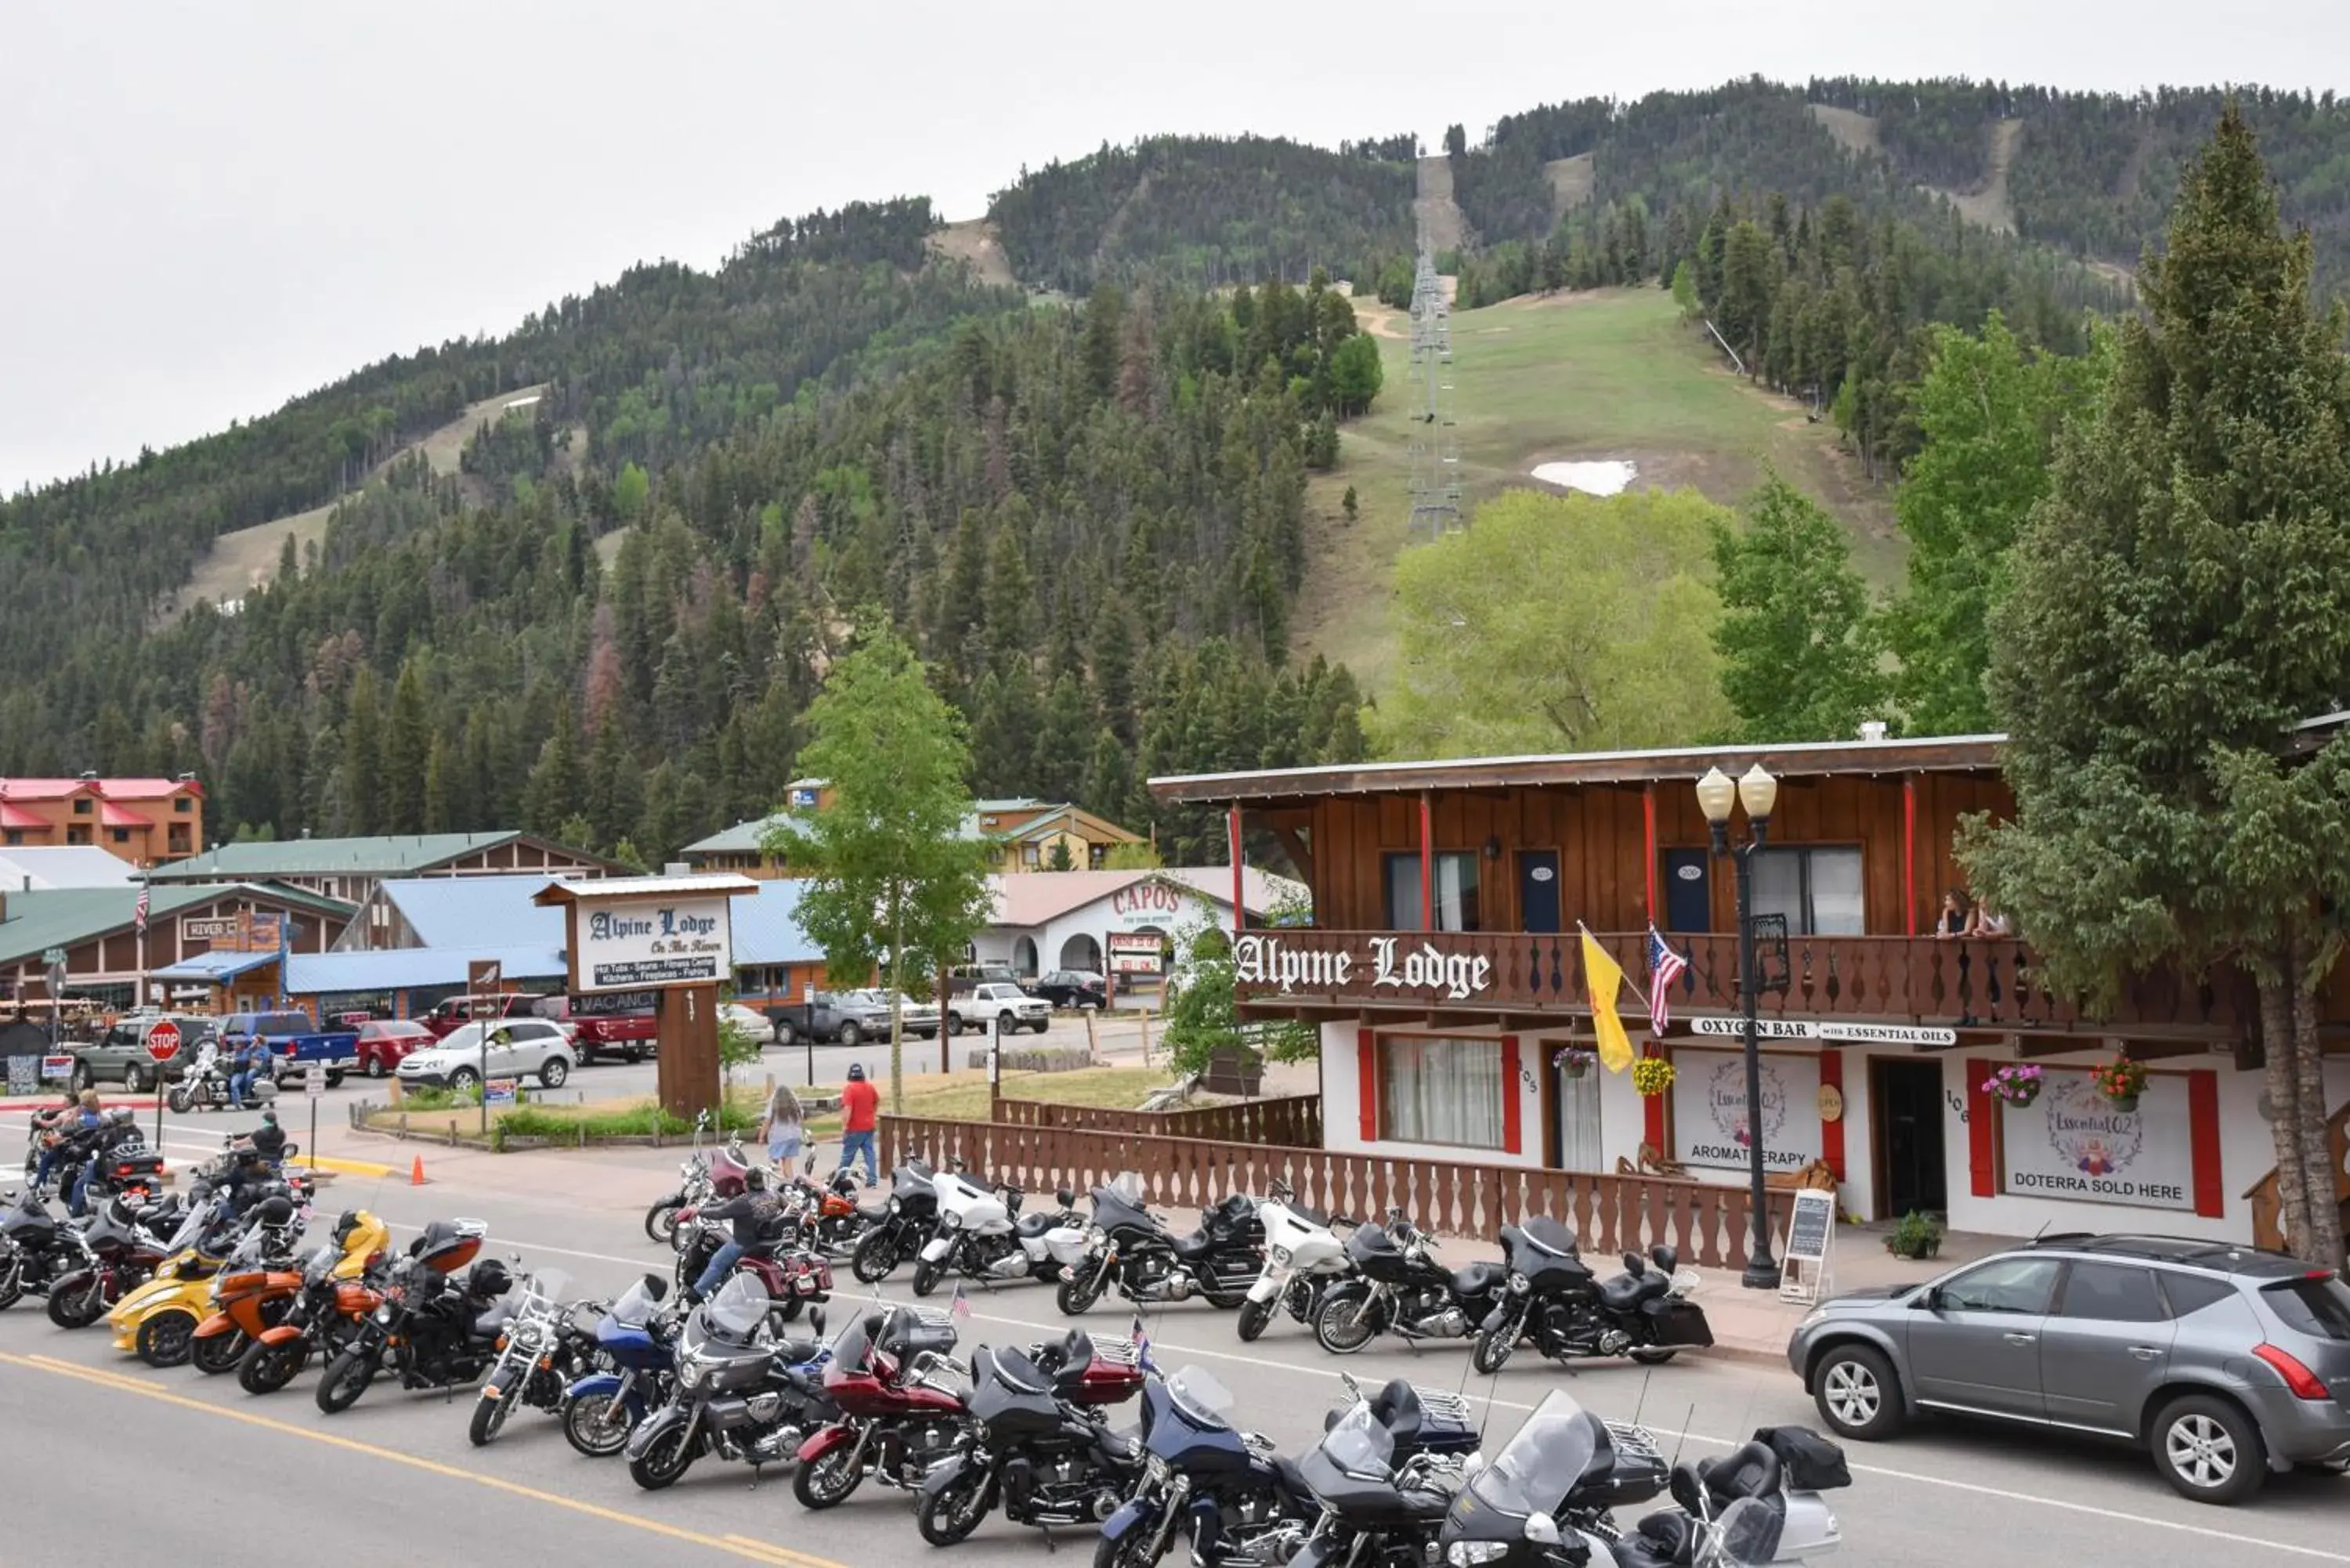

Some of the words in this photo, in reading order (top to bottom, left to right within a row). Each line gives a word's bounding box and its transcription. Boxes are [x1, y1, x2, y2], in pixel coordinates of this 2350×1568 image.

[1113, 884, 1180, 915] CAPO'S
[591, 911, 653, 940] Alpine
[657, 906, 716, 936] Lodge
[1235, 935, 1352, 992] Alpine
[1368, 937, 1491, 999] Lodge
[1701, 1021, 1767, 1035] OXYGN
[1773, 1022, 1807, 1036] BAR
[1847, 1028, 1918, 1040] ESSENTIAL
[1922, 1031, 1951, 1042] OILS
[149, 1033, 179, 1050] STOP
[1691, 1144, 1806, 1167] AROMATERAPY
[2014, 1172, 2088, 1191] DOTERRA
[2092, 1180, 2135, 1196] SOLD
[2139, 1183, 2183, 1200] HERE
